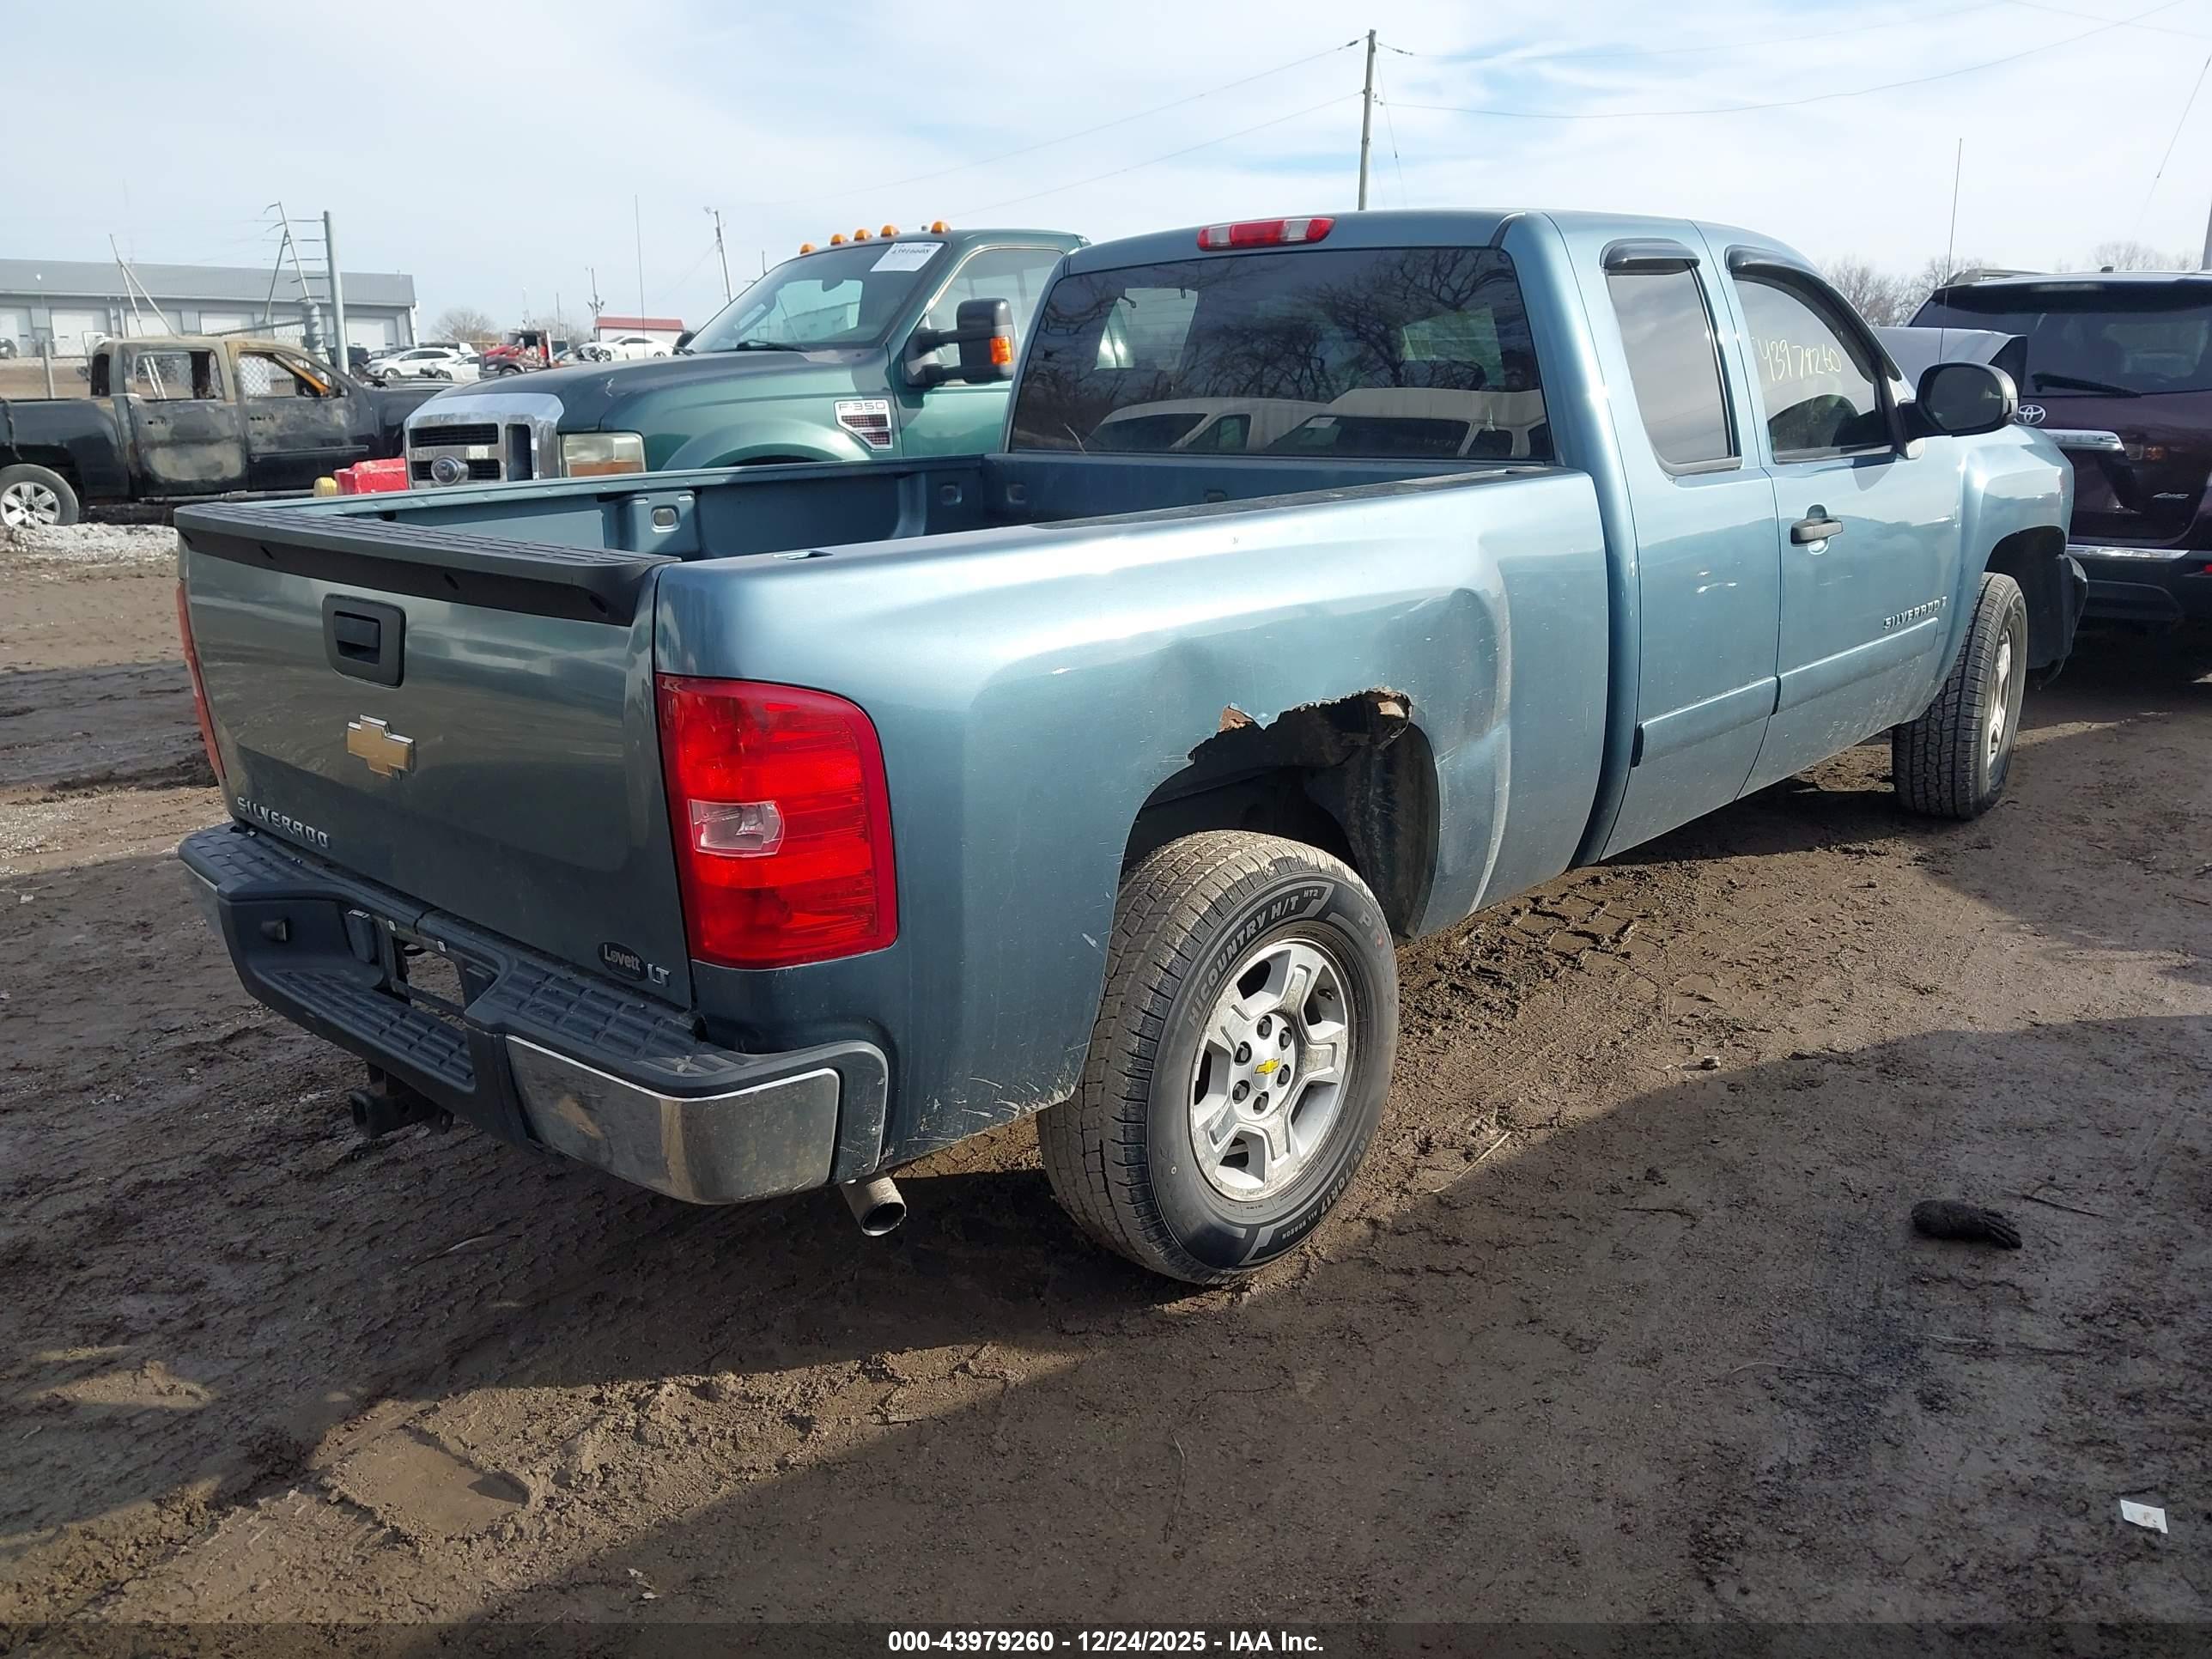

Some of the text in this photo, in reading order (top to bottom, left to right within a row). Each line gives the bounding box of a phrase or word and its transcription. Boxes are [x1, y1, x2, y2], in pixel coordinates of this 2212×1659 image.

[1757, 339, 1842, 381] 43979260
[1882, 599, 1940, 629] SILVERADO
[237, 796, 328, 848] SILVERADO
[1270, 895, 1299, 921] H/T
[1303, 889, 1320, 898] HT2
[604, 944, 641, 973] Lovett
[647, 963, 670, 987] LT
